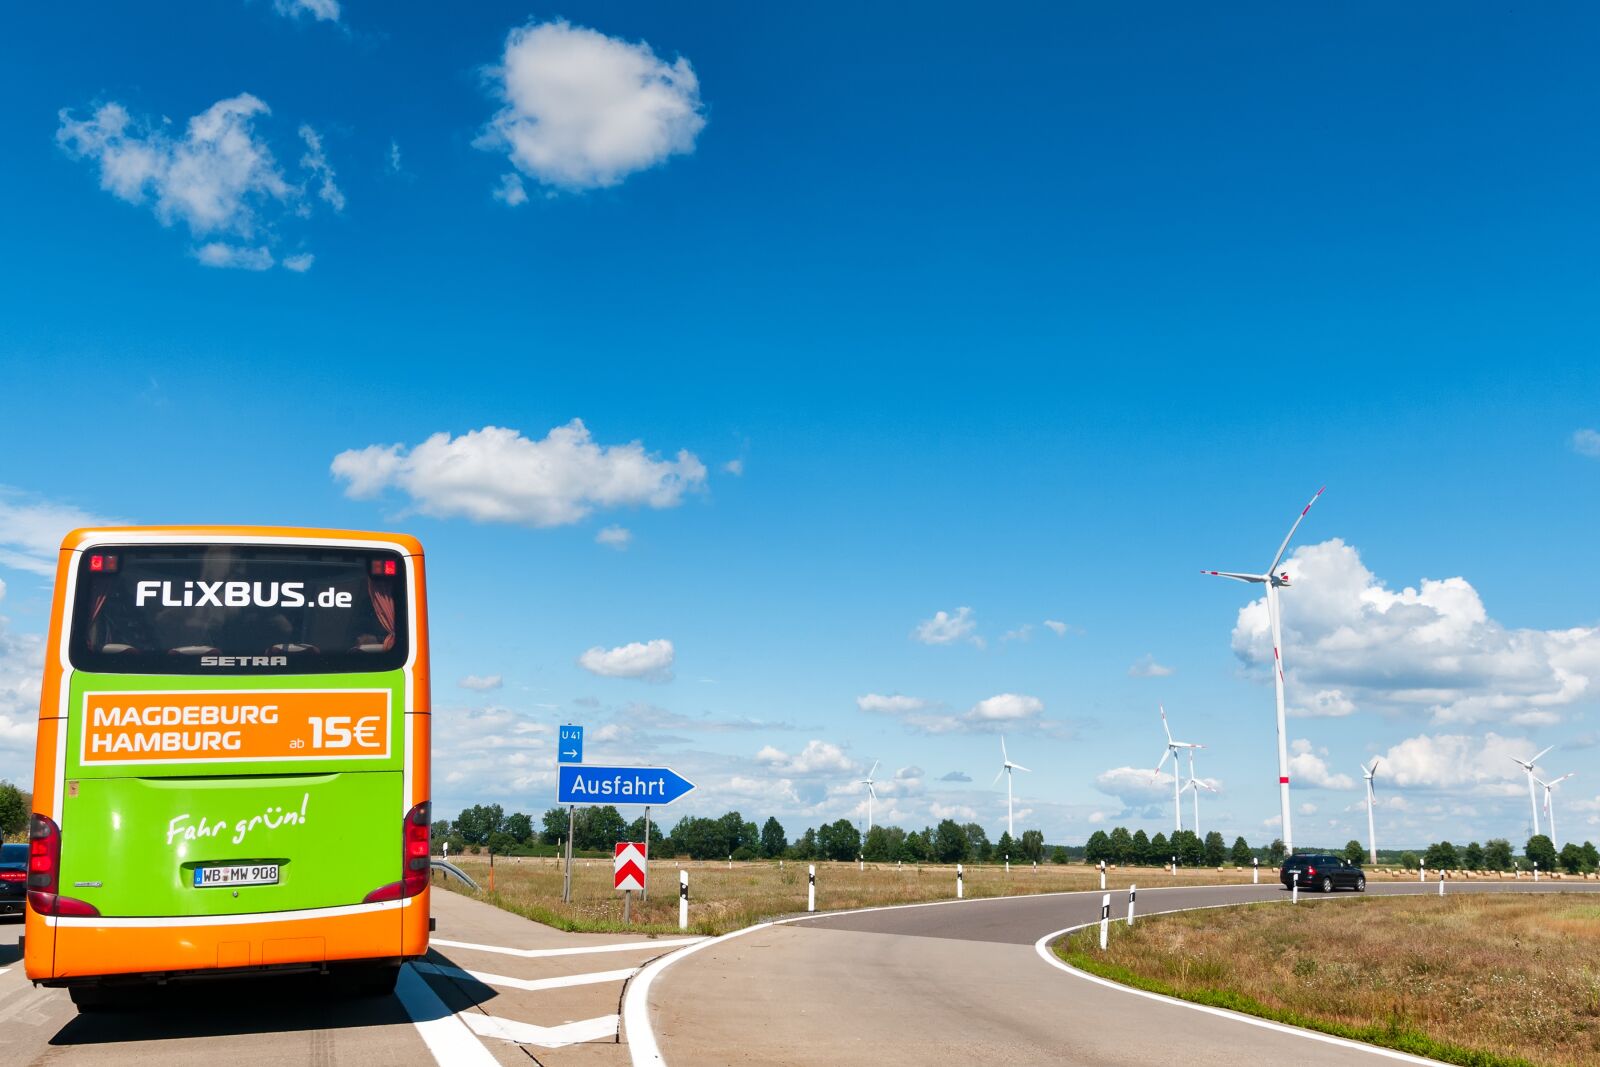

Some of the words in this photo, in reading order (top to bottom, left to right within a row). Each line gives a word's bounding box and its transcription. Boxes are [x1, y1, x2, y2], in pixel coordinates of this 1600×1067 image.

[136, 581, 352, 607] FLiXBUS.de
[201, 656, 287, 666] SETRA
[93, 705, 278, 726] MAGDEBURG
[92, 731, 241, 752] HAMBURG
[289, 737, 304, 749] ab
[308, 716, 380, 748] 15€
[562, 731, 569, 739] U
[571, 731, 580, 739] 41
[571, 775, 665, 795] Ausfahrt
[167, 814, 226, 845] Fahr
[232, 792, 309, 844] grün!
[204, 869, 221, 881] WB
[231, 868, 248, 880] MW
[252, 866, 277, 879] 908
